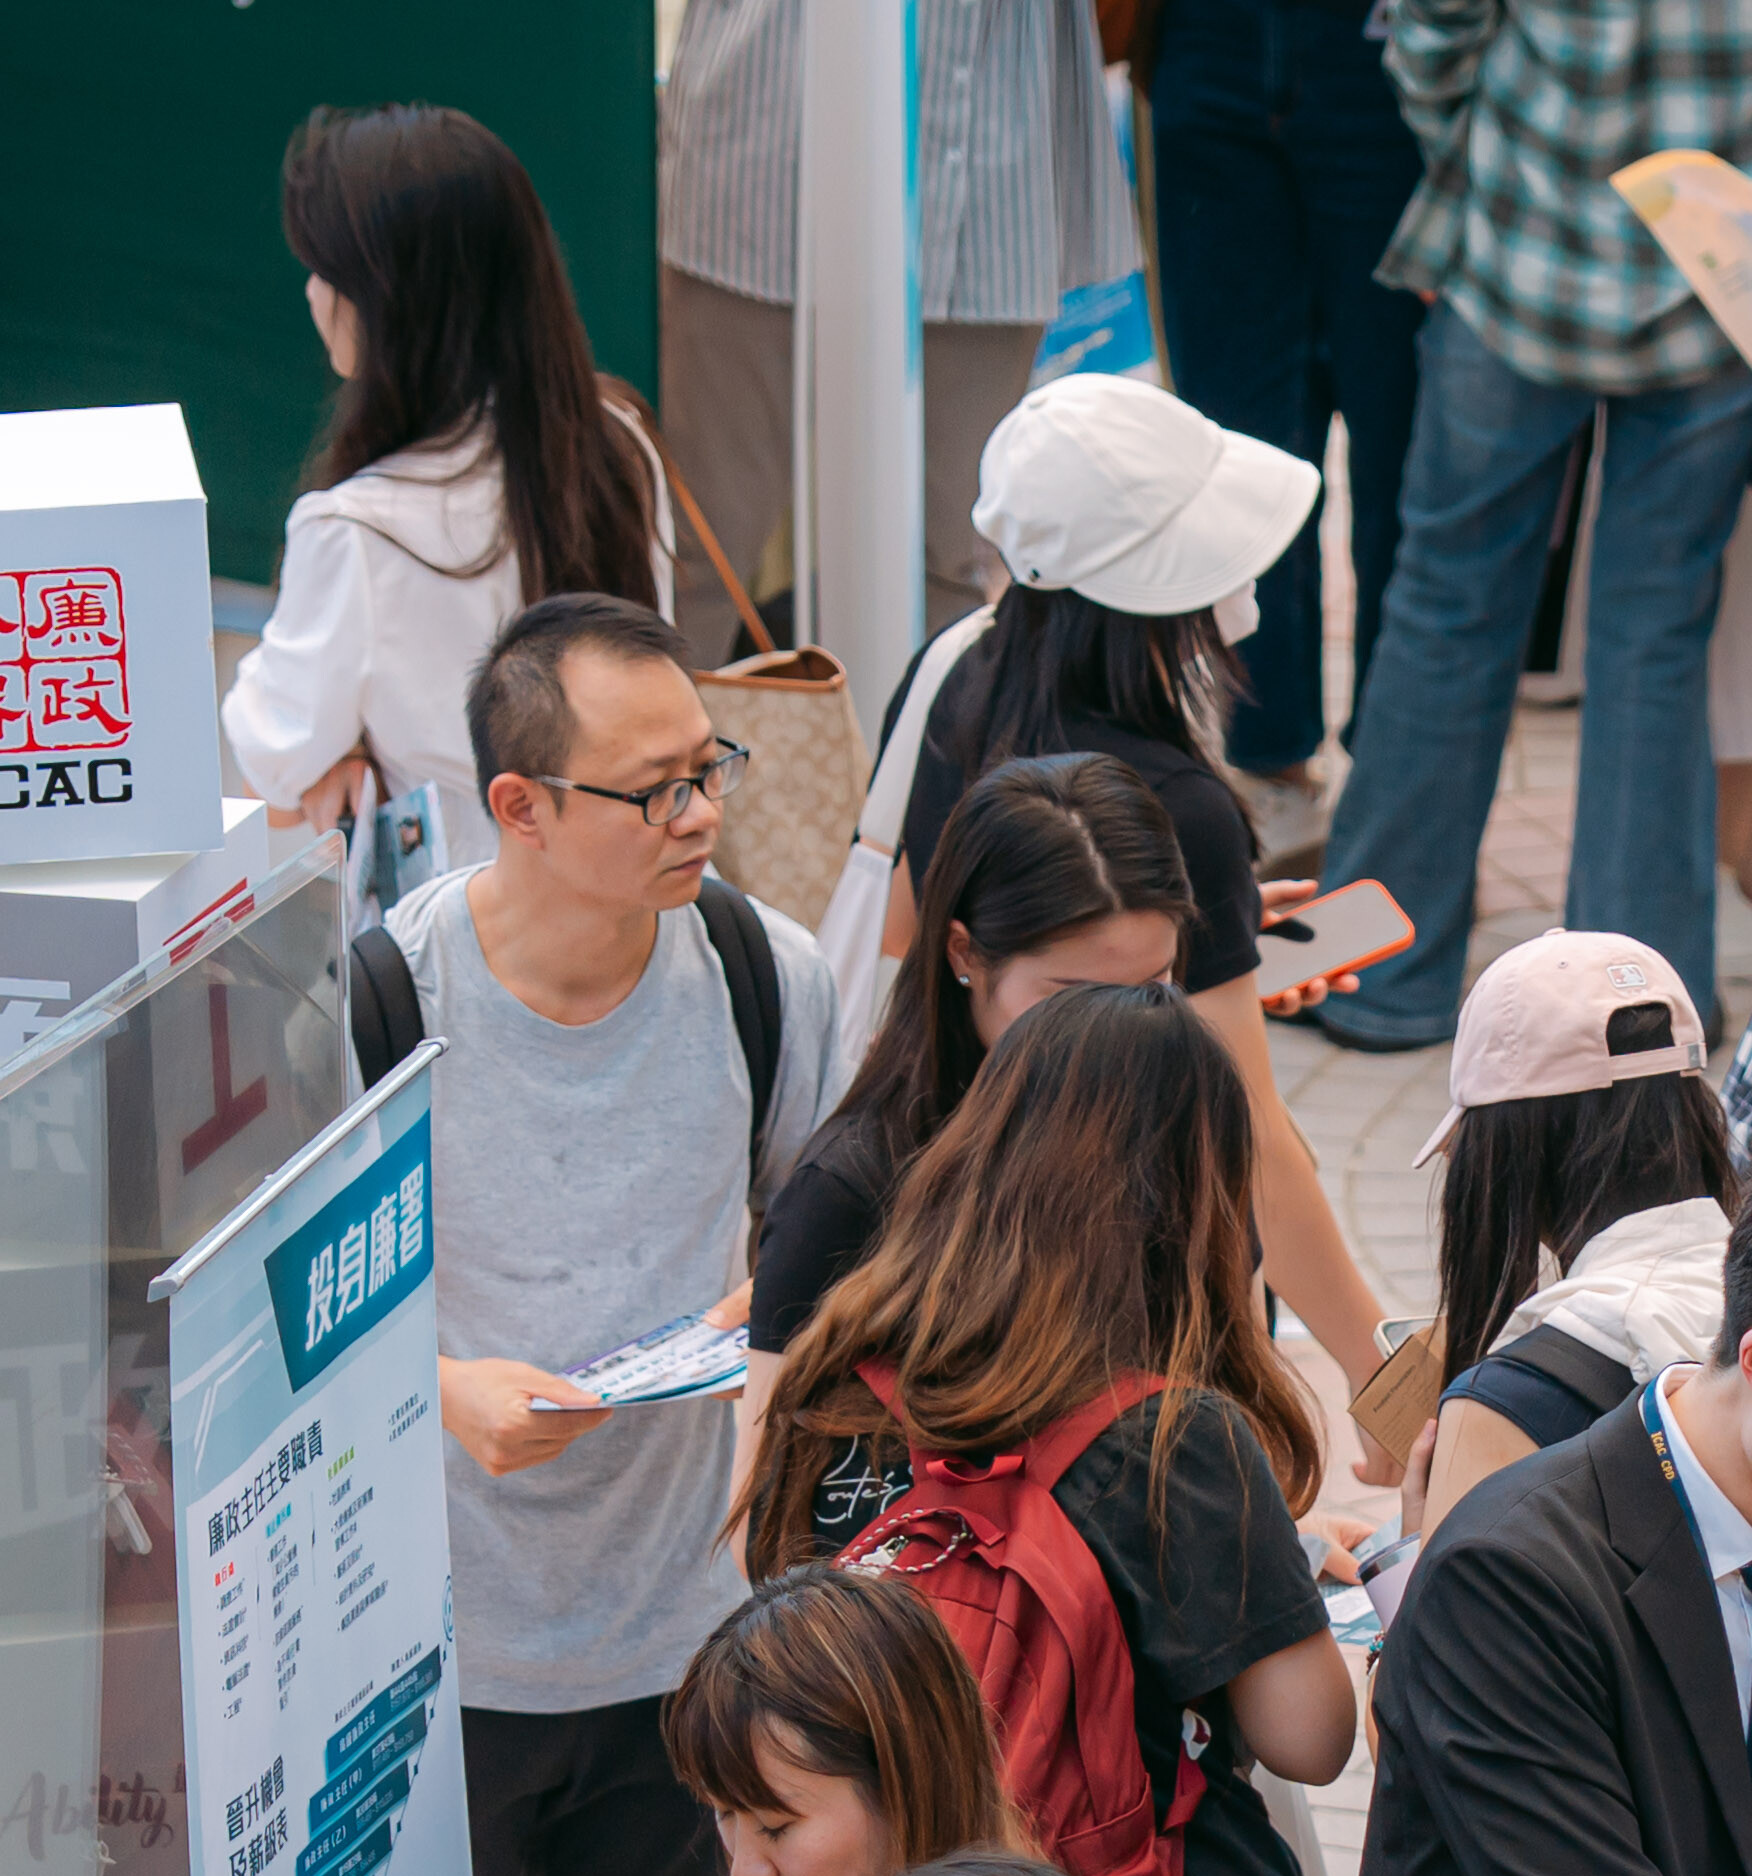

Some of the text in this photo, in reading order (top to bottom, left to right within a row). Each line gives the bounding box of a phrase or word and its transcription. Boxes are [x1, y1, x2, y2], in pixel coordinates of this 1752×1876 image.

[305, 1162, 425, 1353] 投身廉署
[208, 1418, 323, 1558] 廉政主任主要職責
[1650, 1431, 1676, 1481] ICAC CPD
[225, 1754, 286, 1843] 晉升機會
